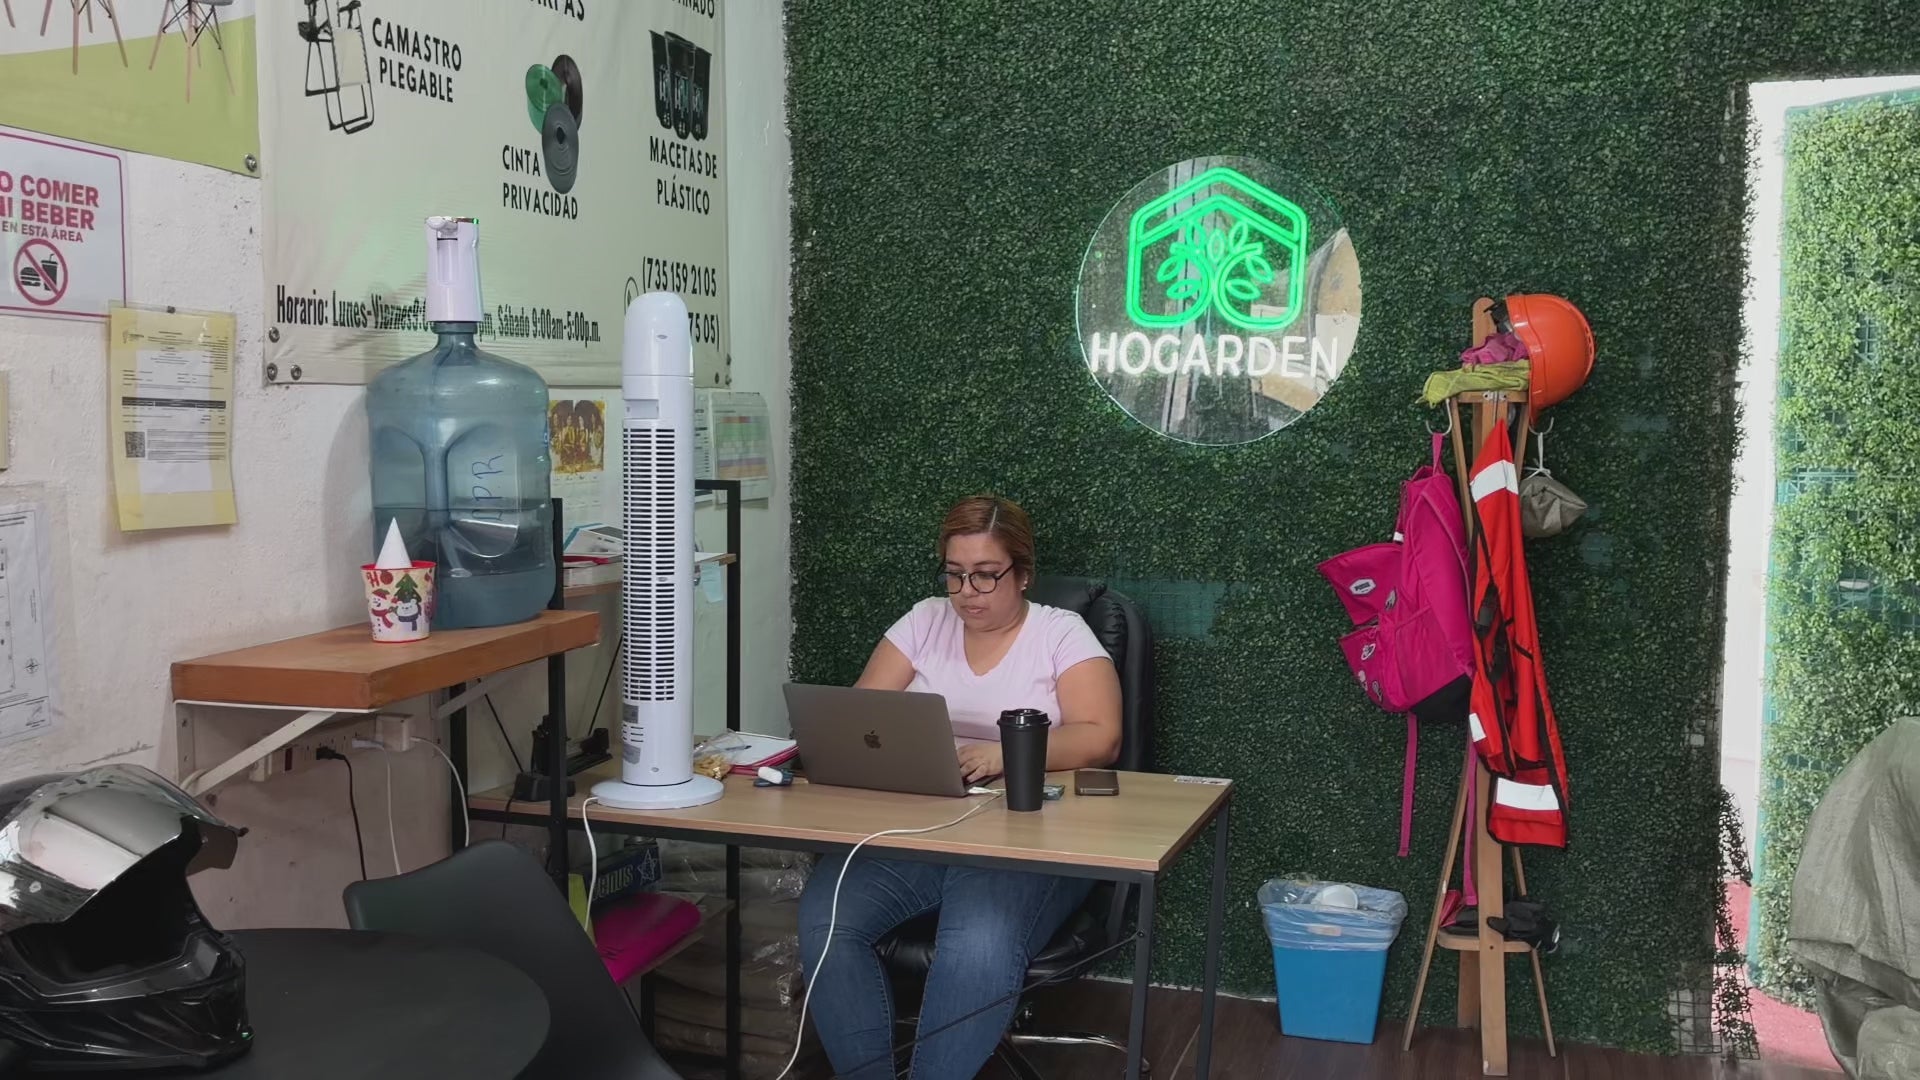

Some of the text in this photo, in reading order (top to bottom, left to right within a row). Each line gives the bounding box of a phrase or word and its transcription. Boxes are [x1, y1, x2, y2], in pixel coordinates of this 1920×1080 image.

[372, 17, 462, 72] CAMASTRO
[379, 56, 454, 103] PLEGABLE
[502, 144, 541, 177] CINTA
[650, 135, 718, 179] MACETAS DE
[0, 170, 99, 208] O COMER
[503, 182, 578, 220] PRIVACIDAD
[657, 173, 710, 216] PLÁSTICO
[1, 220, 84, 243] EN ESTA ÁREA
[21, 199, 95, 231] BEBER
[642, 256, 668, 294] (735
[671, 261, 688, 294] 159
[276, 284, 329, 326] Horario:
[498, 303, 530, 339] Sábado
[1090, 331, 1339, 379] HOGARDEN
